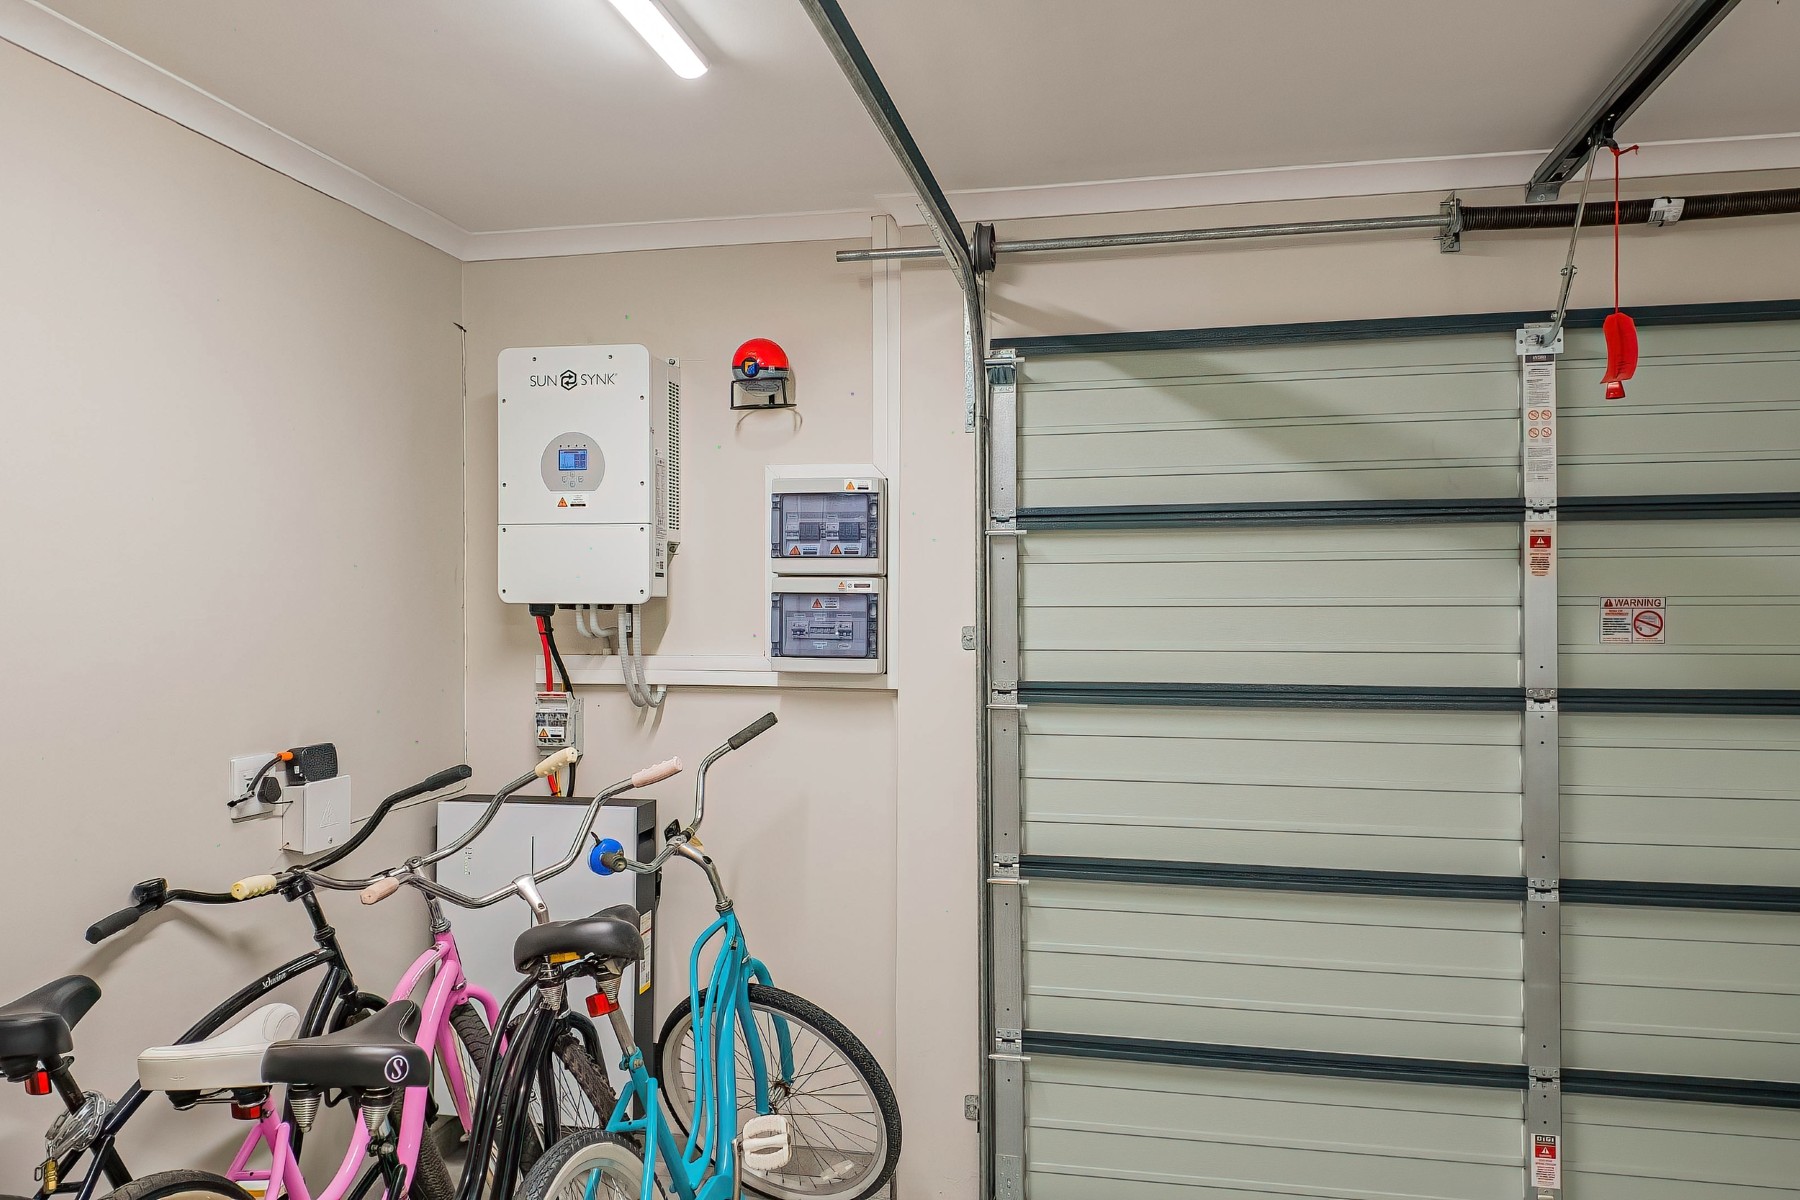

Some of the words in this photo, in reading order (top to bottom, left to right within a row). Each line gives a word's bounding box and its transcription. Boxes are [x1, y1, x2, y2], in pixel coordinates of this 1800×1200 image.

[530, 375, 558, 387] SUN
[580, 373, 616, 386] SYNK
[1614, 598, 1662, 607] WARNING
[391, 1058, 403, 1080] S
